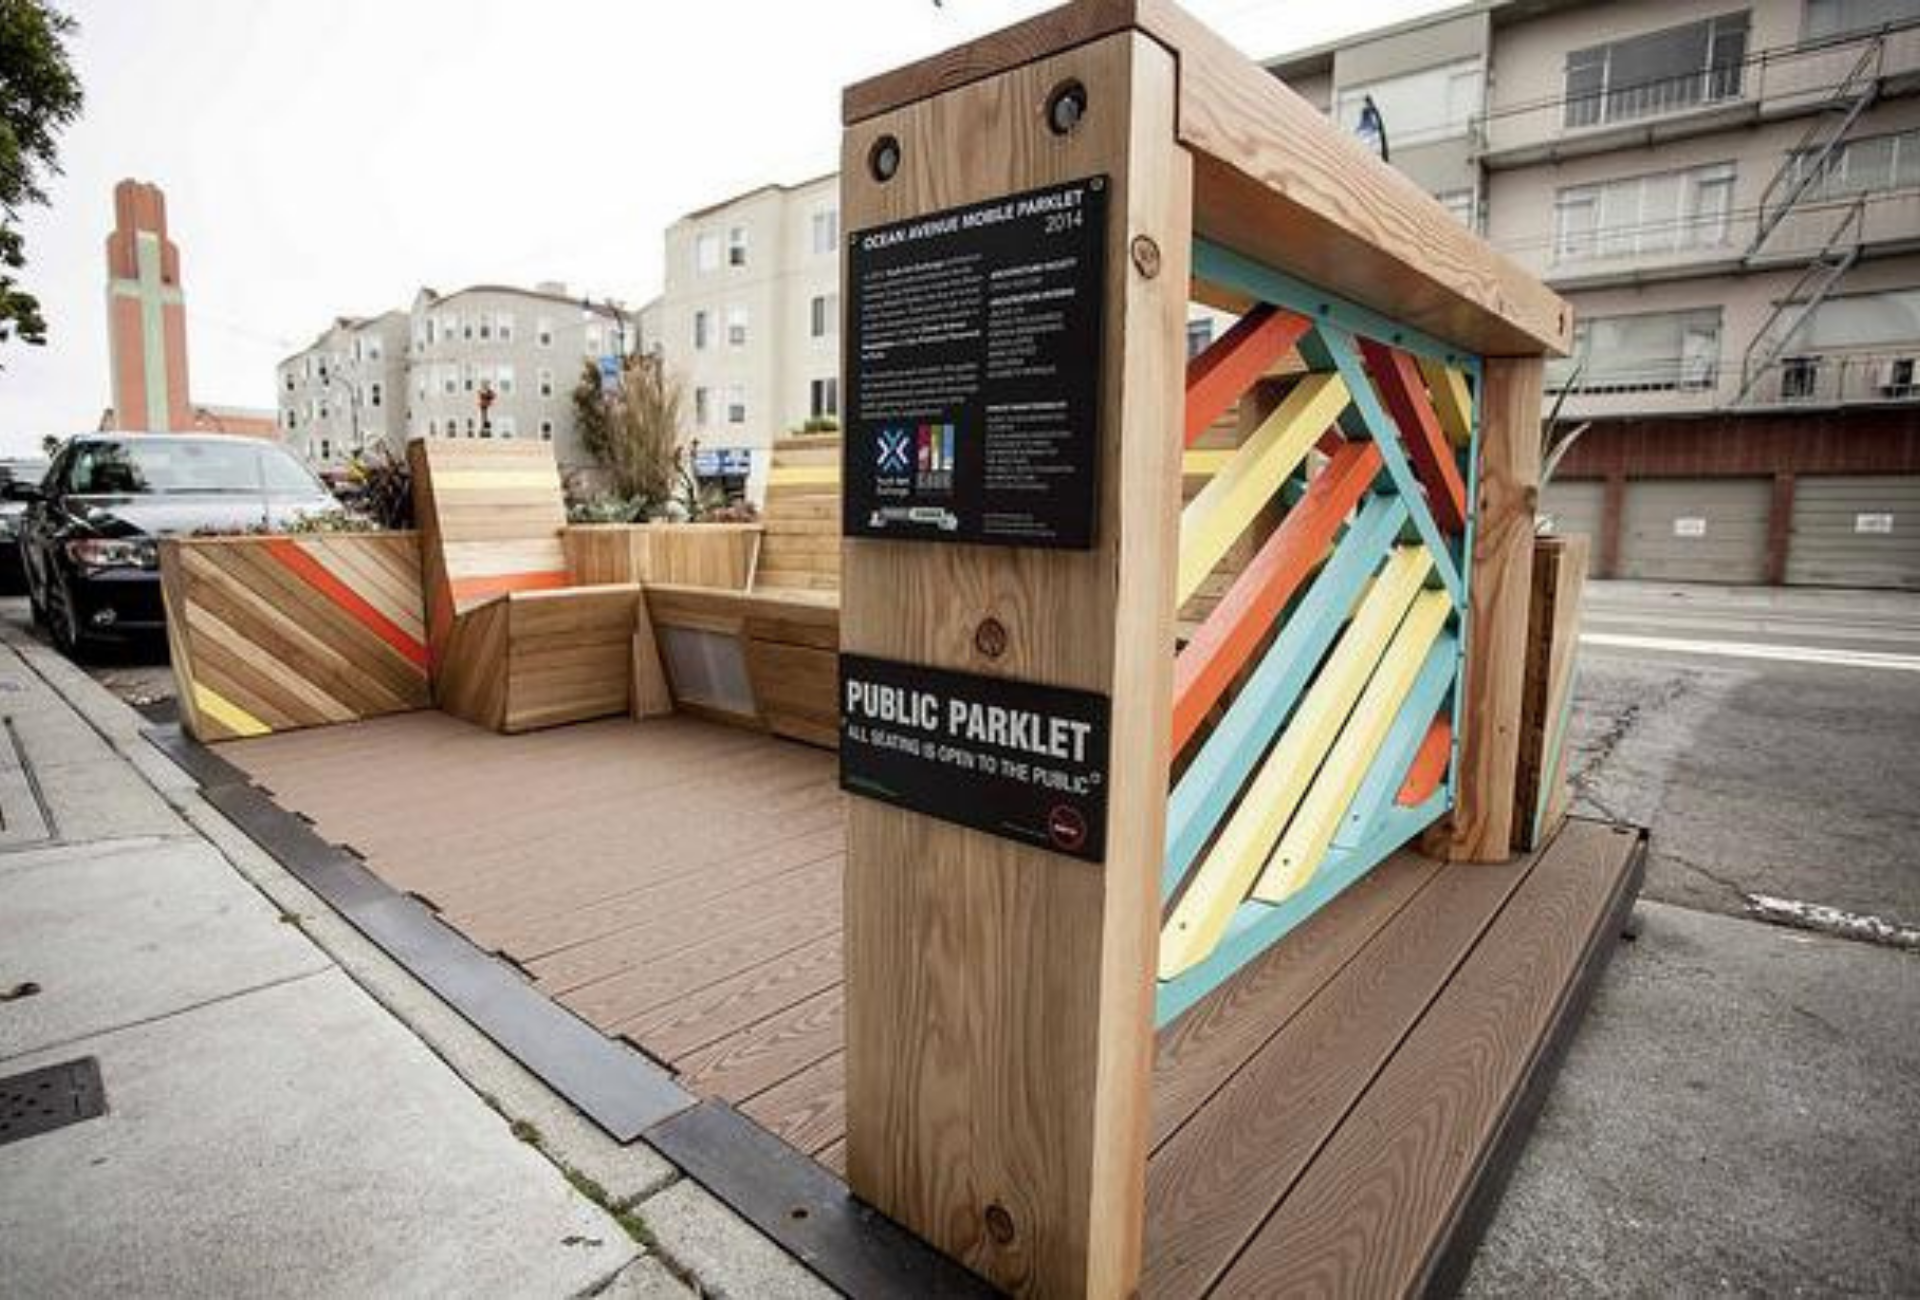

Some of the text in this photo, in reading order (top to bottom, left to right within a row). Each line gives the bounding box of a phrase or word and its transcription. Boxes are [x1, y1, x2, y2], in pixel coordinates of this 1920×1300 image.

[863, 189, 1083, 249] OCEAN AVENUE MOBILE PARKLET
[1045, 209, 1083, 233] 2014
[847, 680, 1091, 763] PUBLIC PARKLET
[848, 725, 1088, 795] ALL SEATING IS OPEN TO THE PUBLIC
